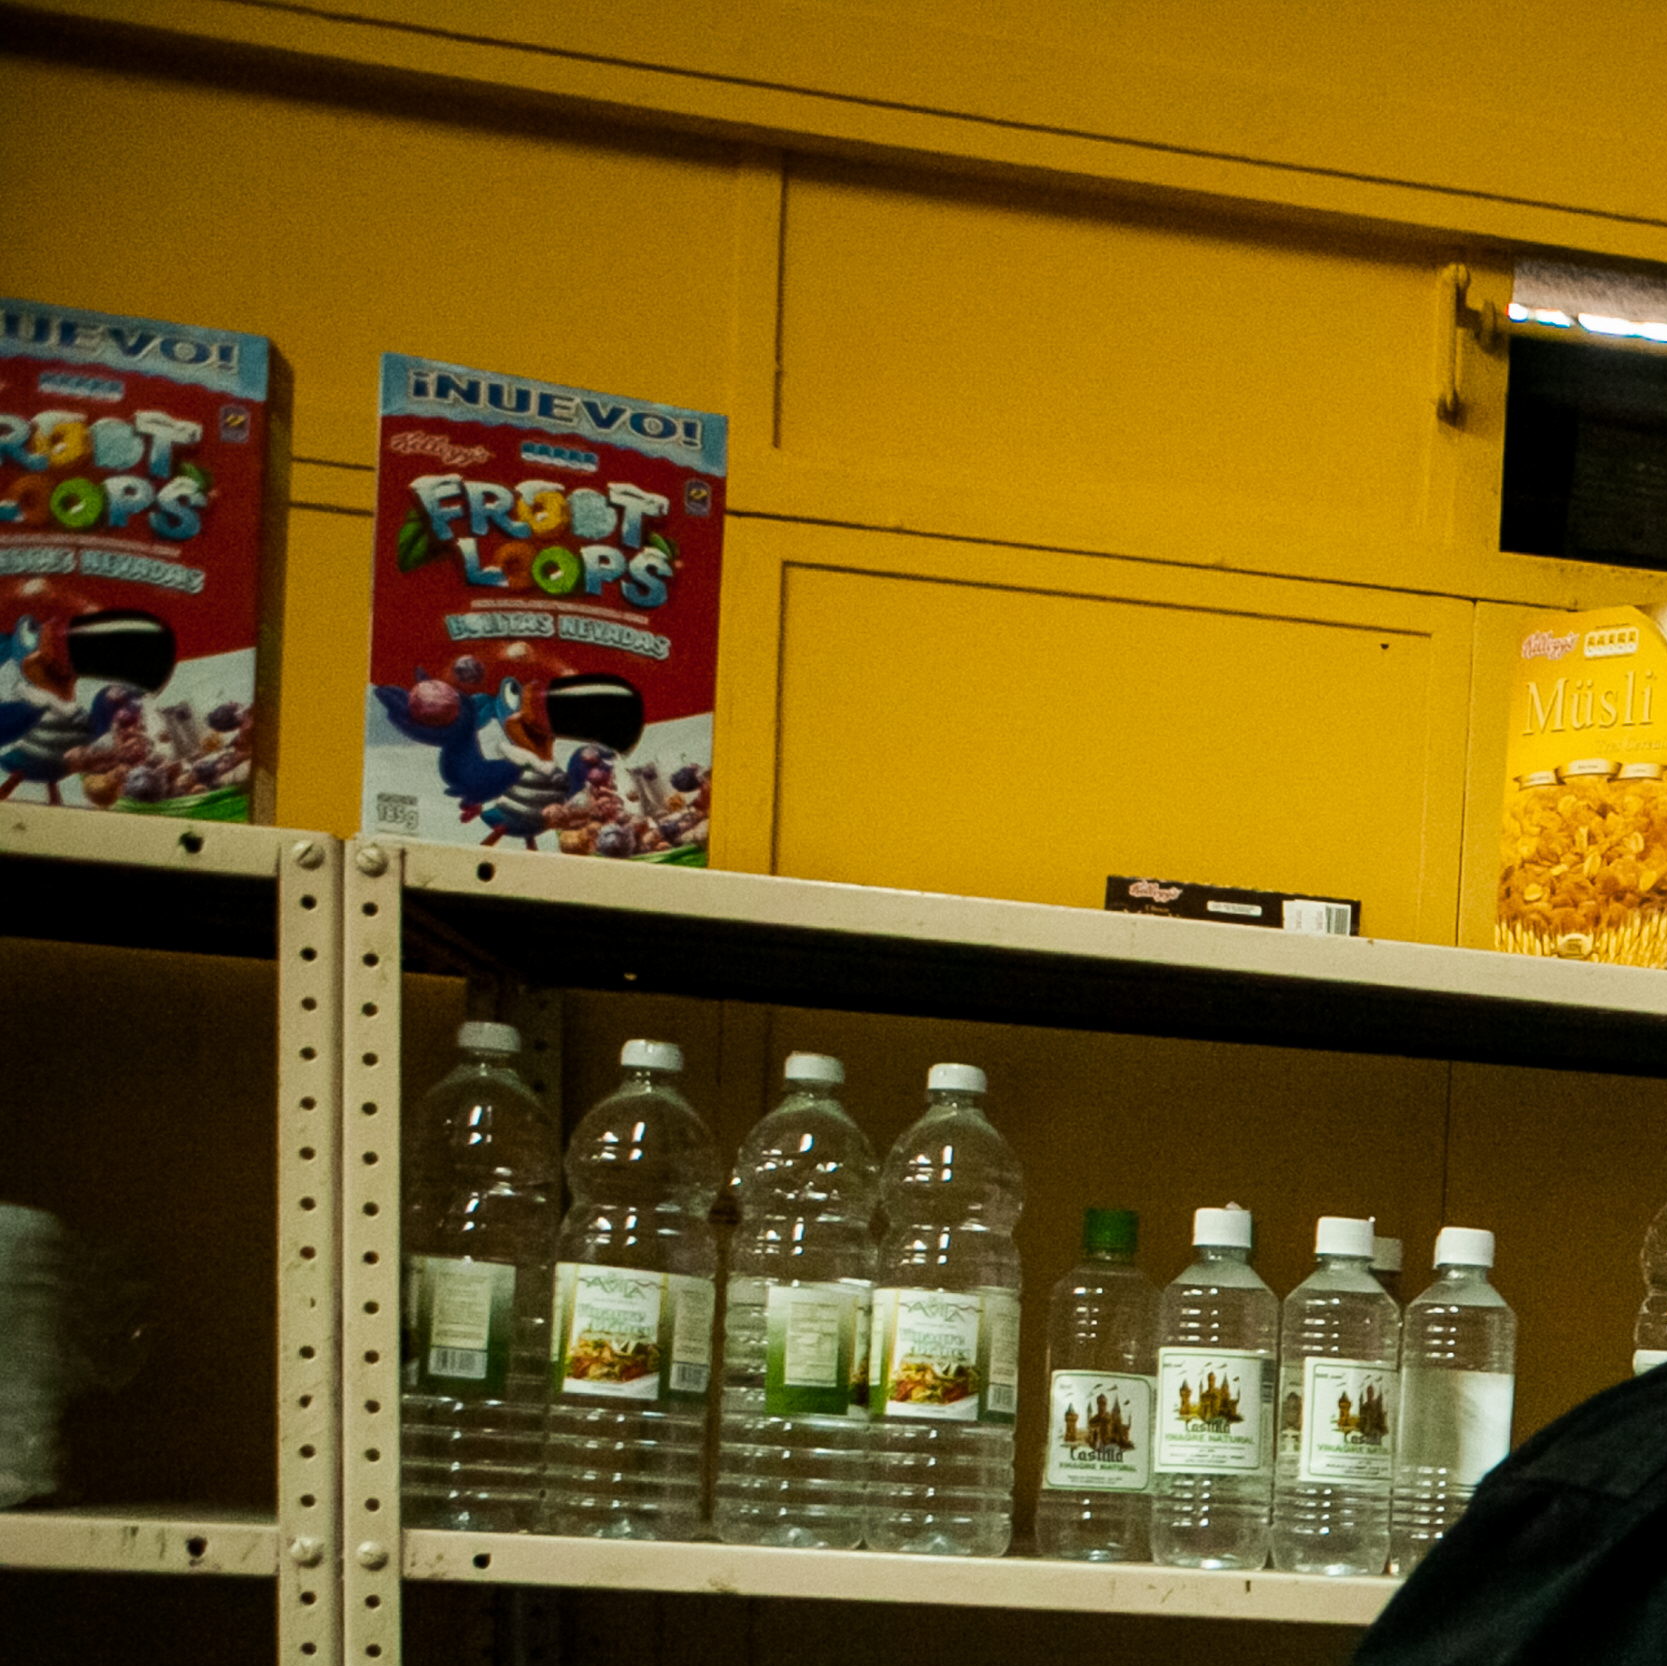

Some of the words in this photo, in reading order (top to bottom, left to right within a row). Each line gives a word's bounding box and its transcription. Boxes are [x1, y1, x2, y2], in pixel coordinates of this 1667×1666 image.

[409, 370, 702, 448] ¡NUEVO!
[457, 537, 673, 608] LOOPS
[1522, 671, 1657, 736] Müsli
